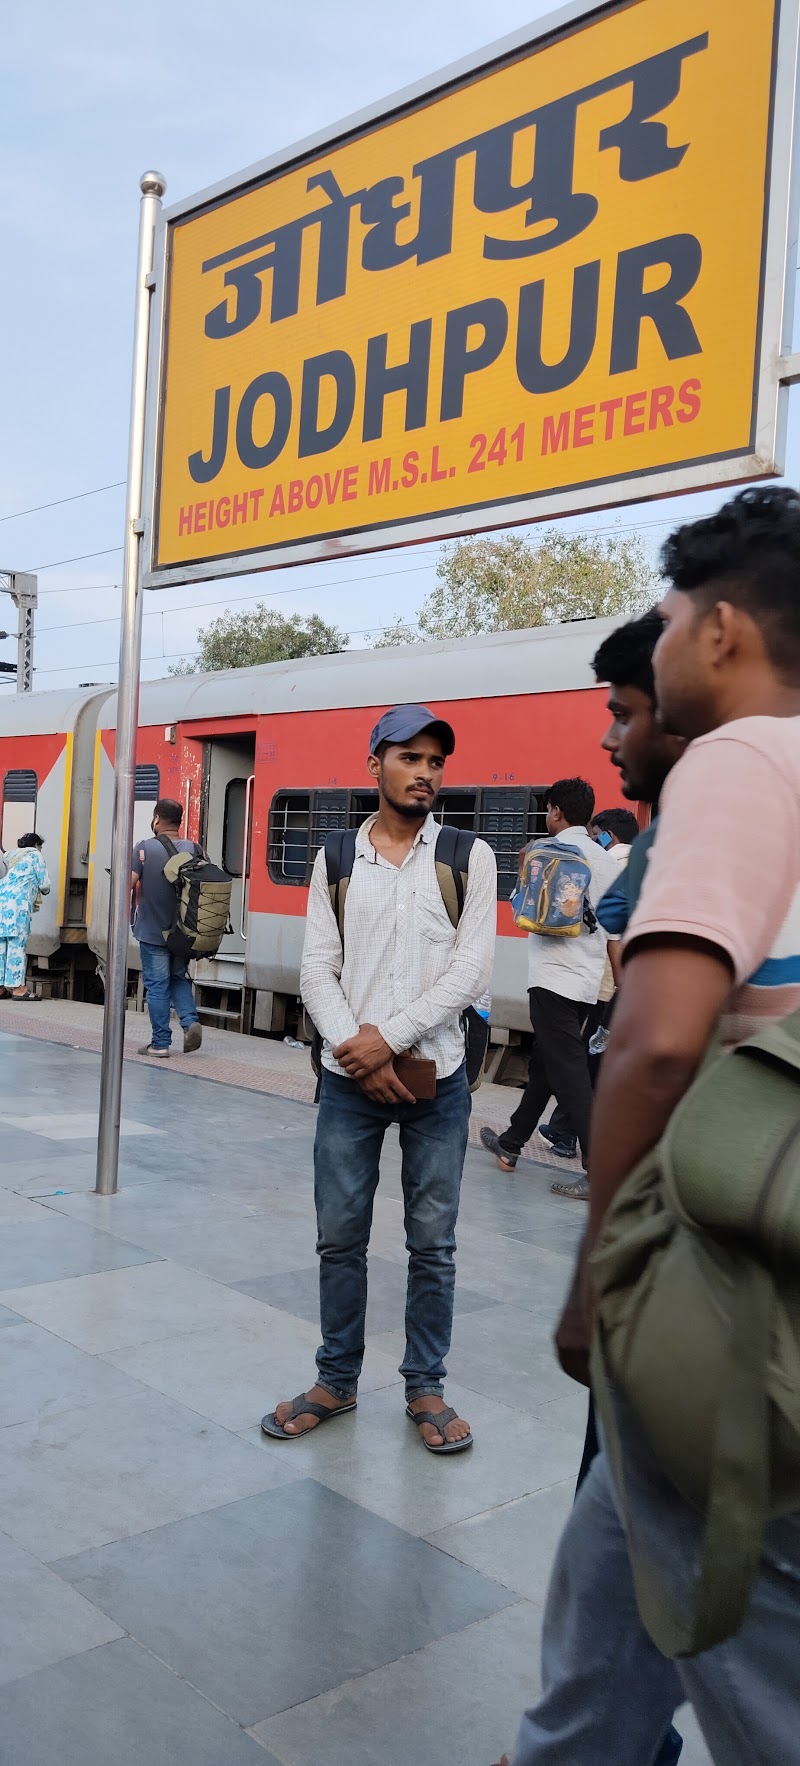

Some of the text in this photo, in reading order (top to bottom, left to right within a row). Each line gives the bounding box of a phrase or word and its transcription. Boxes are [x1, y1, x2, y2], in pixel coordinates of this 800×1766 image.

[202, 32, 708, 340] जोधपुर
[178, 378, 702, 537] HEIGHT ABOVE M.S.L. 241 METERS
[188, 234, 703, 483] JODHPUR
